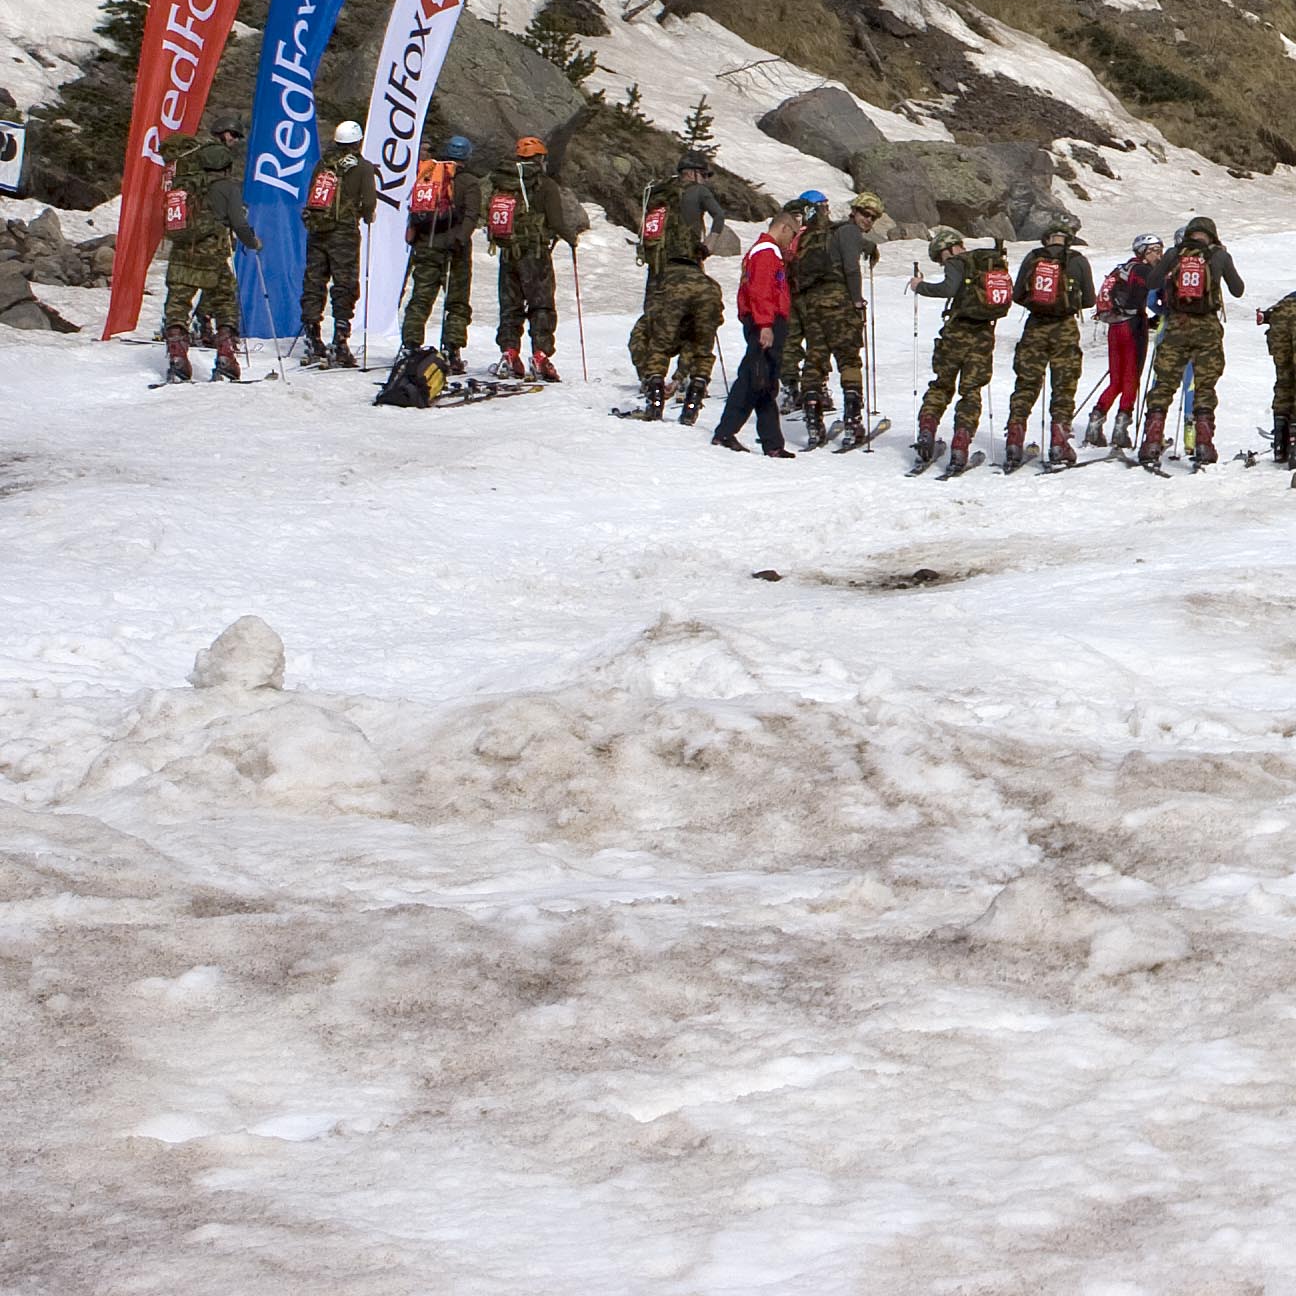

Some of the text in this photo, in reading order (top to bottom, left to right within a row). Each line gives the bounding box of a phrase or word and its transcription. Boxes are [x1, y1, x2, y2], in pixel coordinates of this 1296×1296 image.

[374, 12, 432, 210] RedFox
[314, 187, 329, 202] 91
[416, 188, 433, 202] 94
[167, 205, 182, 222] 84
[492, 211, 509, 225] 93
[1035, 275, 1053, 292] 82
[1182, 272, 1200, 287] 88
[992, 289, 1008, 304] 87
